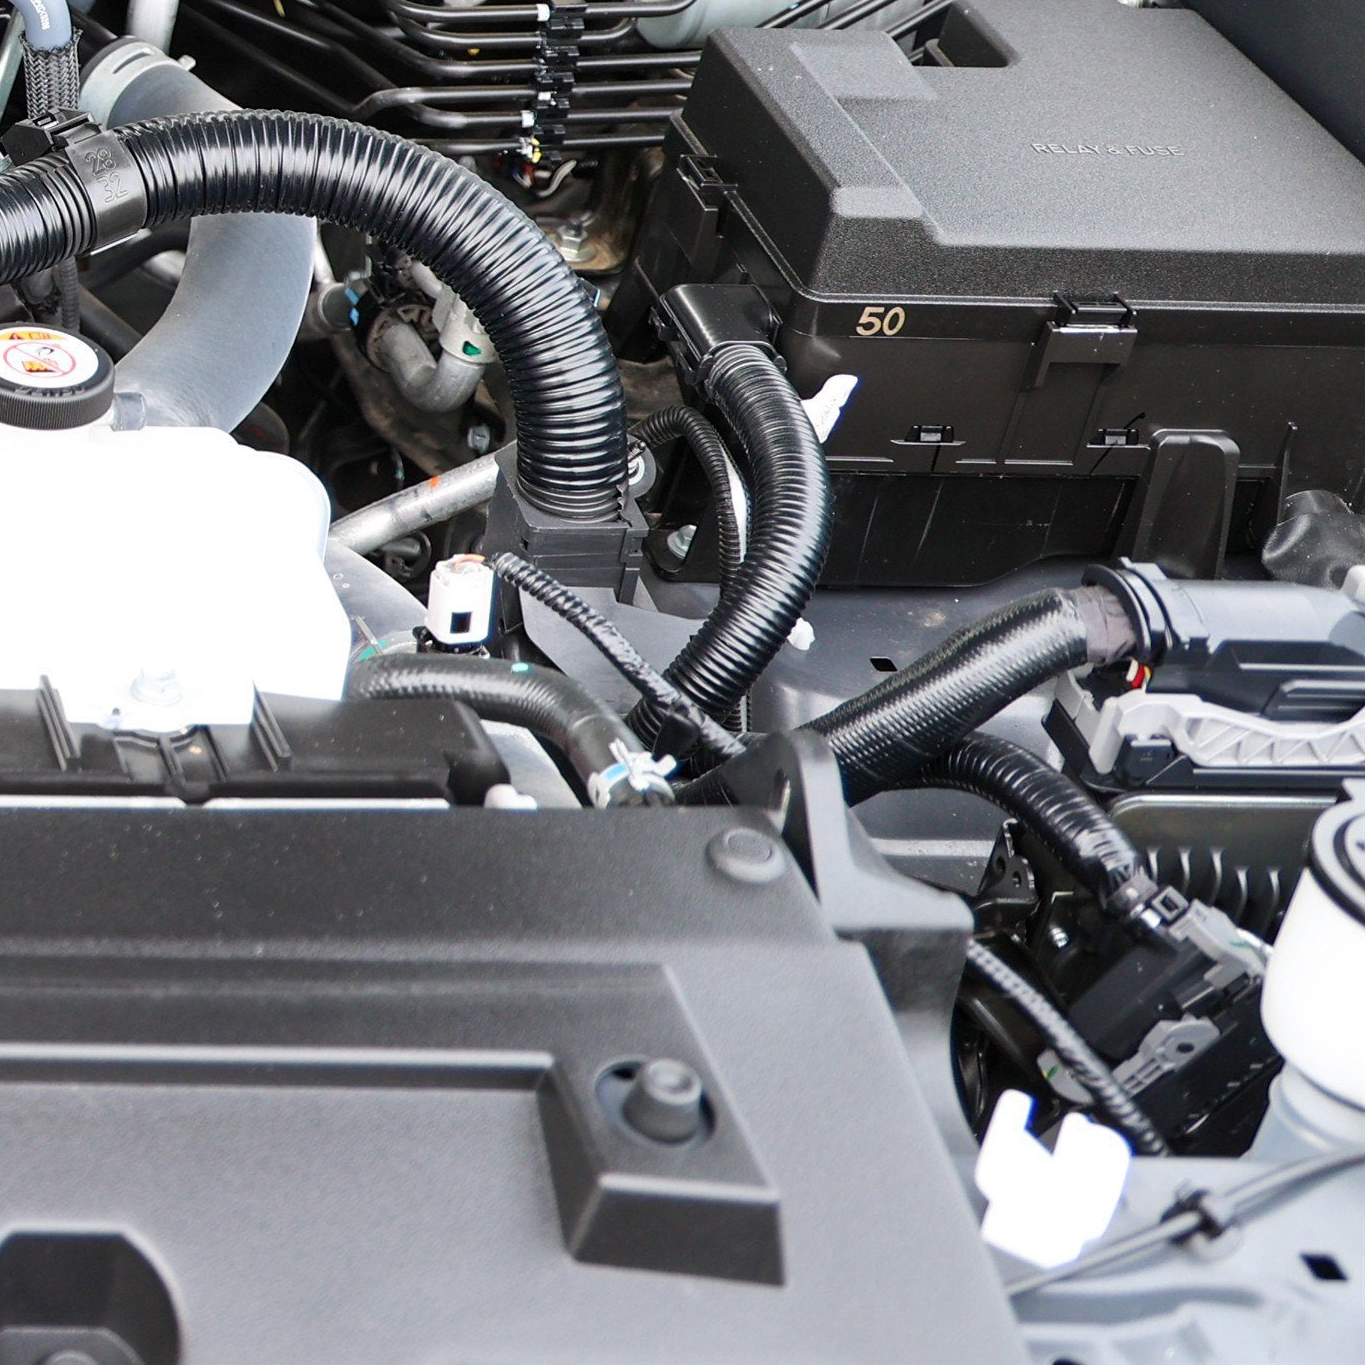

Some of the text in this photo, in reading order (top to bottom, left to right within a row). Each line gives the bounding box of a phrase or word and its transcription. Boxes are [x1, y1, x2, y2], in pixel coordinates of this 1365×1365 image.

[84, 146, 118, 177] 28
[1030, 142, 1186, 157] RELAY & FUSE
[96, 170, 130, 204] 32
[854, 305, 907, 338] 50
